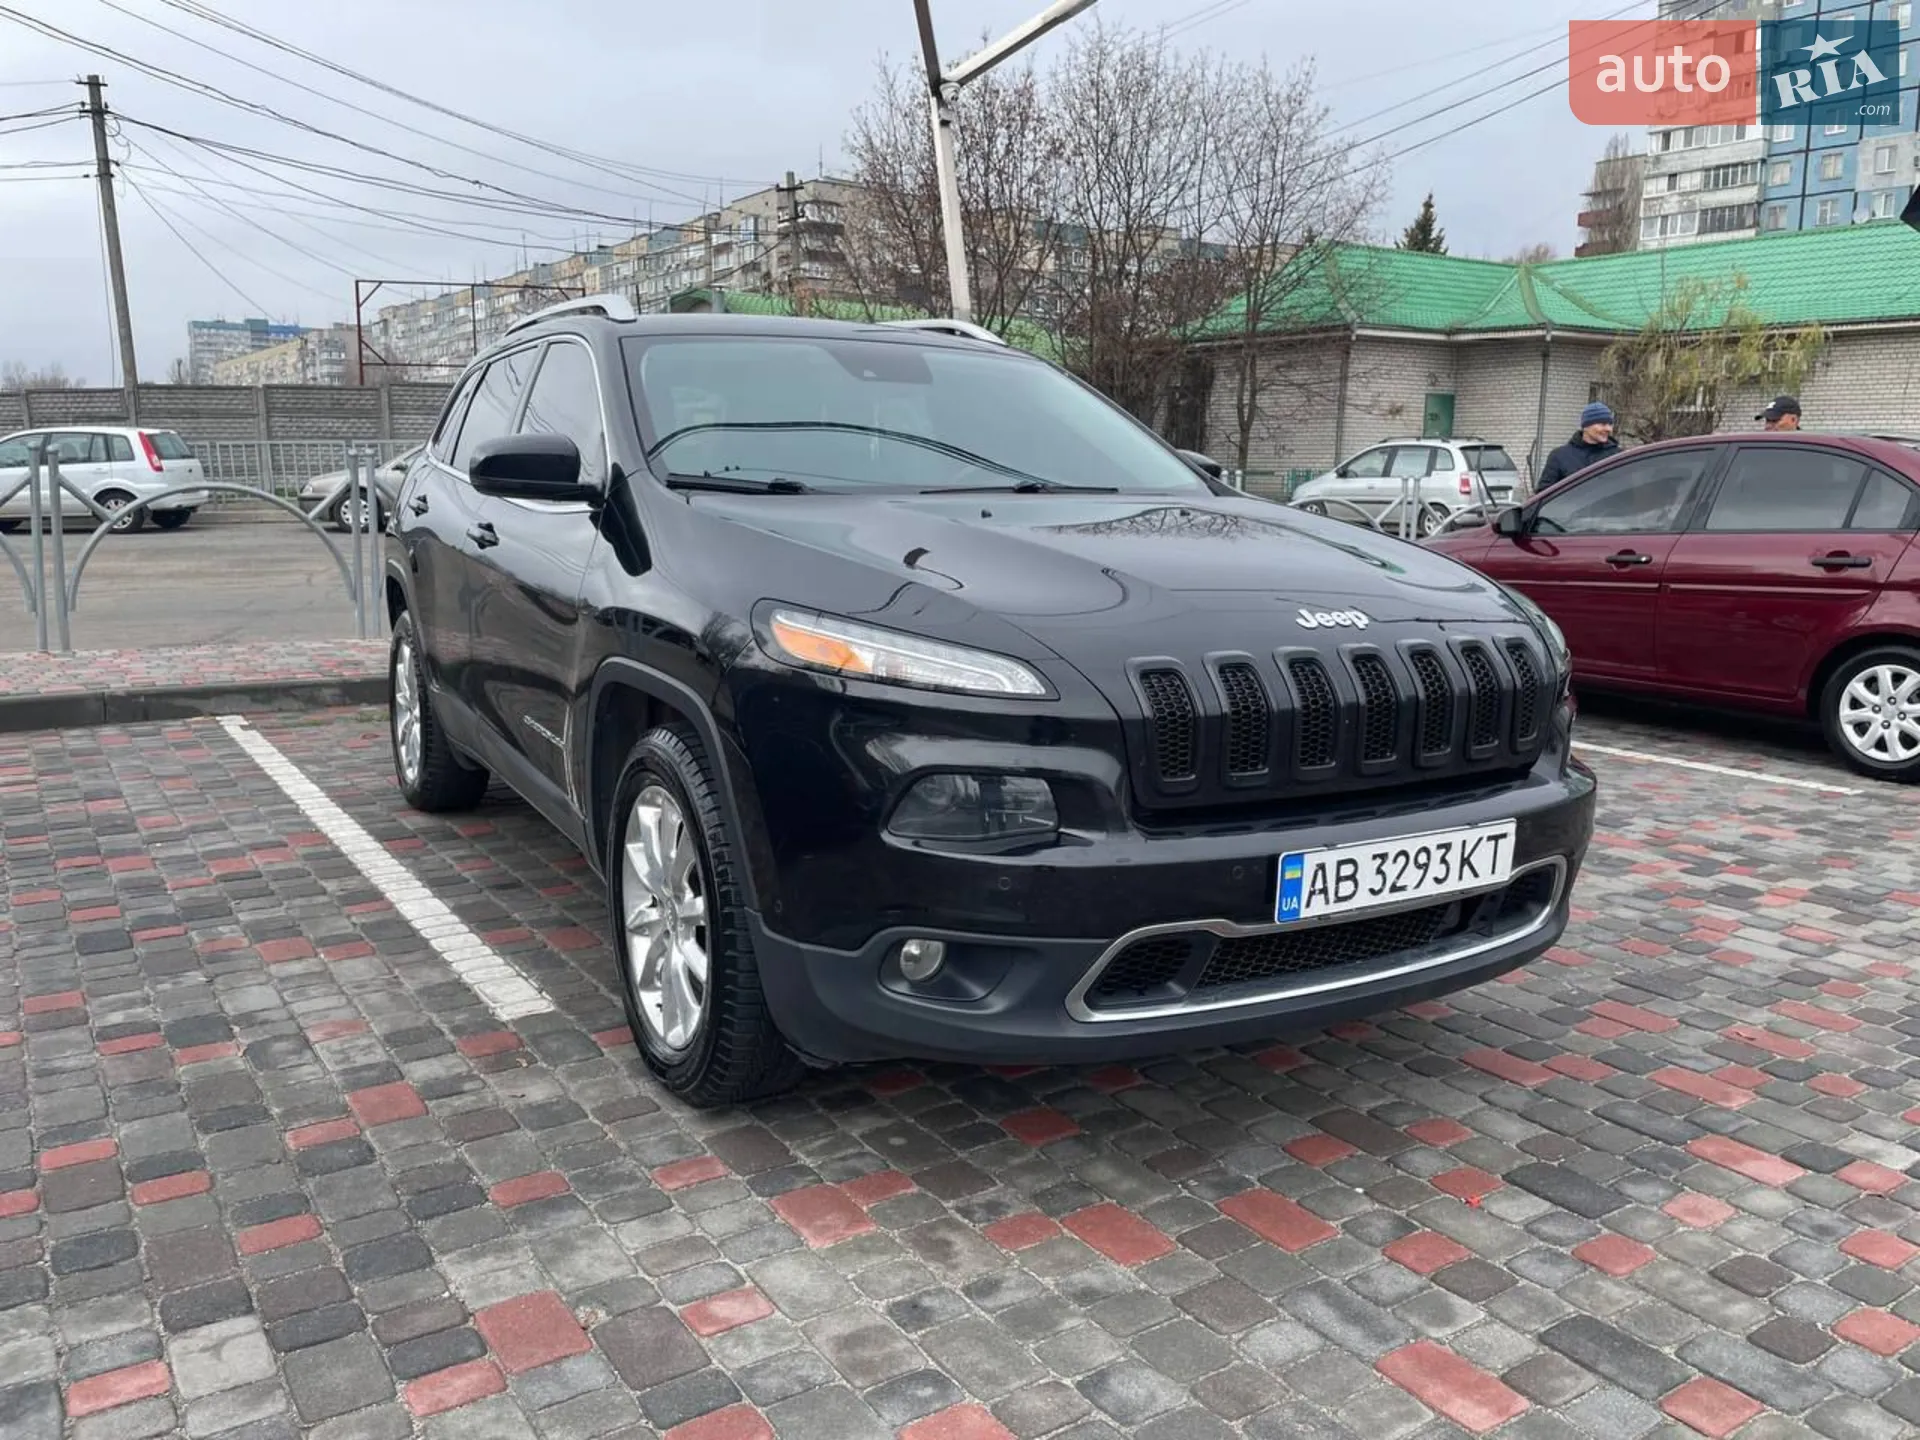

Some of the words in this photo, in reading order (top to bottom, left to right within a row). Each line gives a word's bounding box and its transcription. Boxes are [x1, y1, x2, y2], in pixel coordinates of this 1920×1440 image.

[1296, 609, 1369, 630] Jeep
[1305, 858, 1359, 909] AB
[1368, 841, 1453, 896] 3293
[1458, 833, 1508, 881] KT
[1282, 897, 1299, 911] UA
